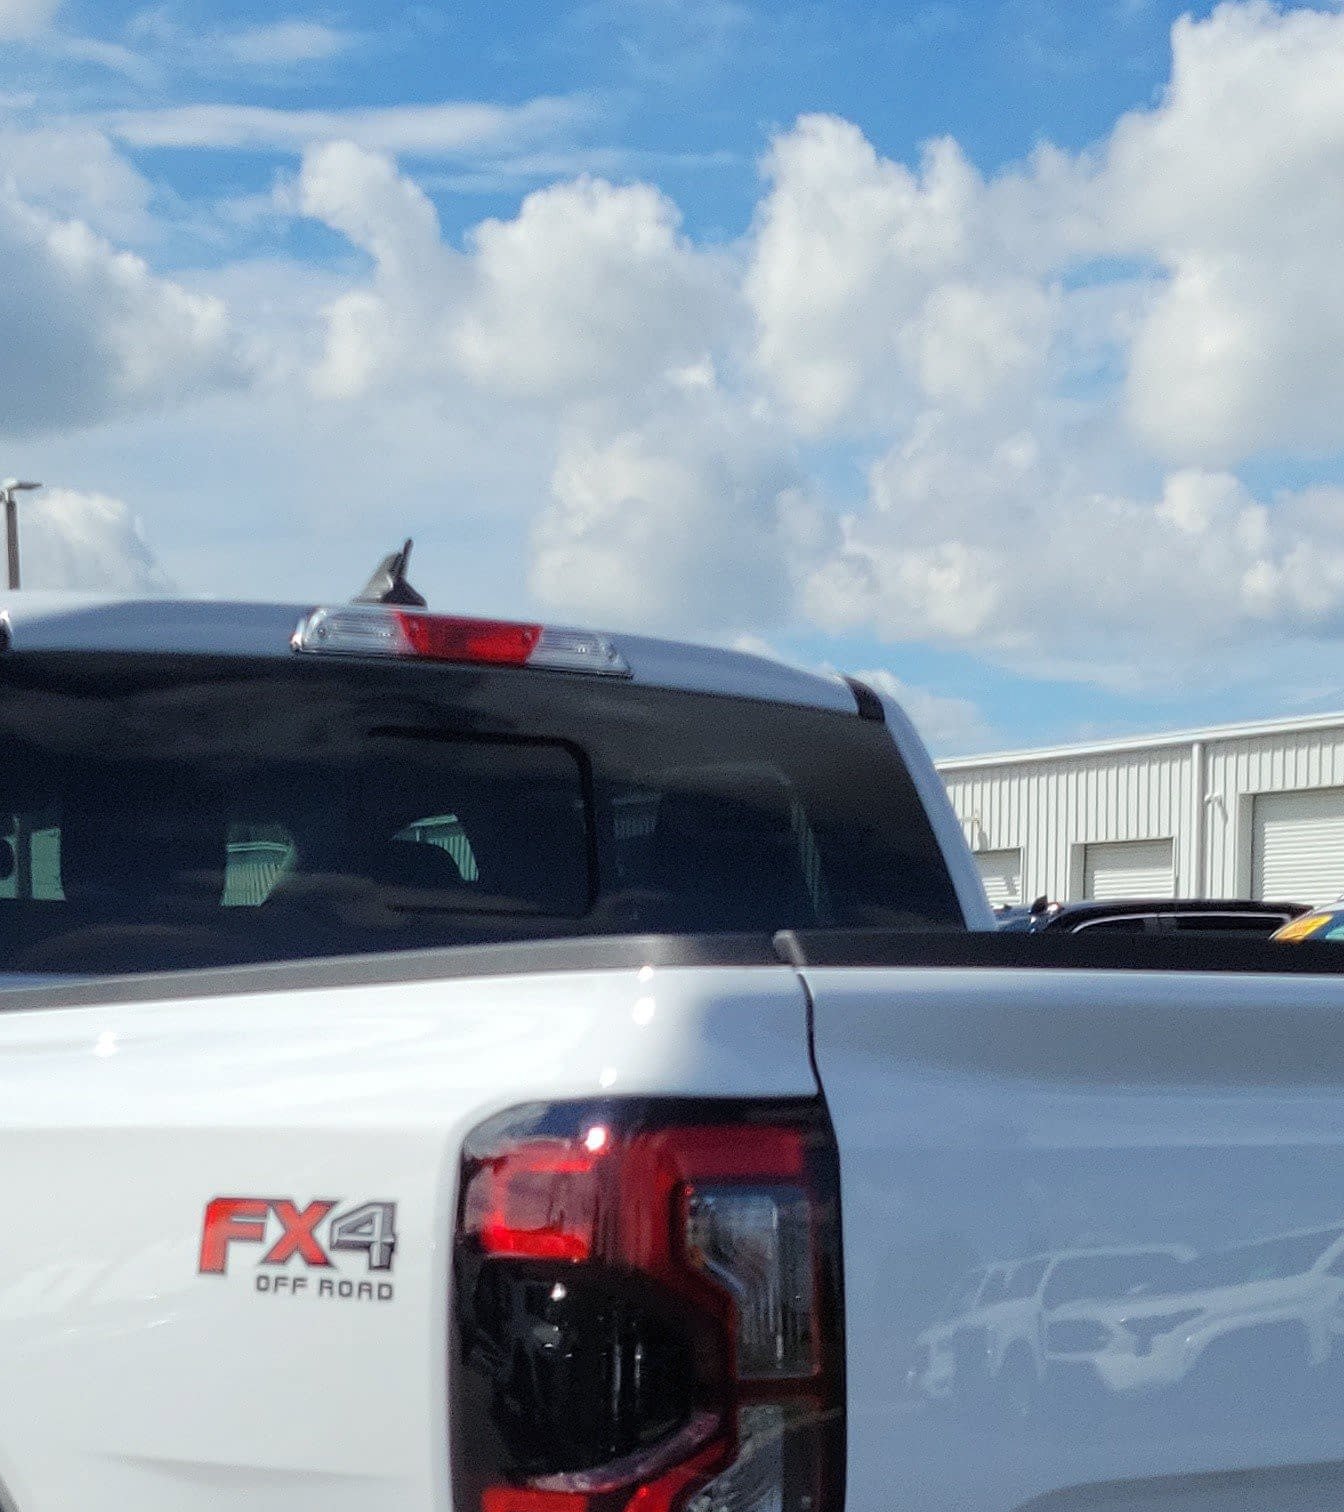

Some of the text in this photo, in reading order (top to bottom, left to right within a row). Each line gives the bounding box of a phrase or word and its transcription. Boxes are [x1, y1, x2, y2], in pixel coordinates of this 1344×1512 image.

[199, 1197, 397, 1275] FX4
[255, 1274, 394, 1301] OFF ROAD
